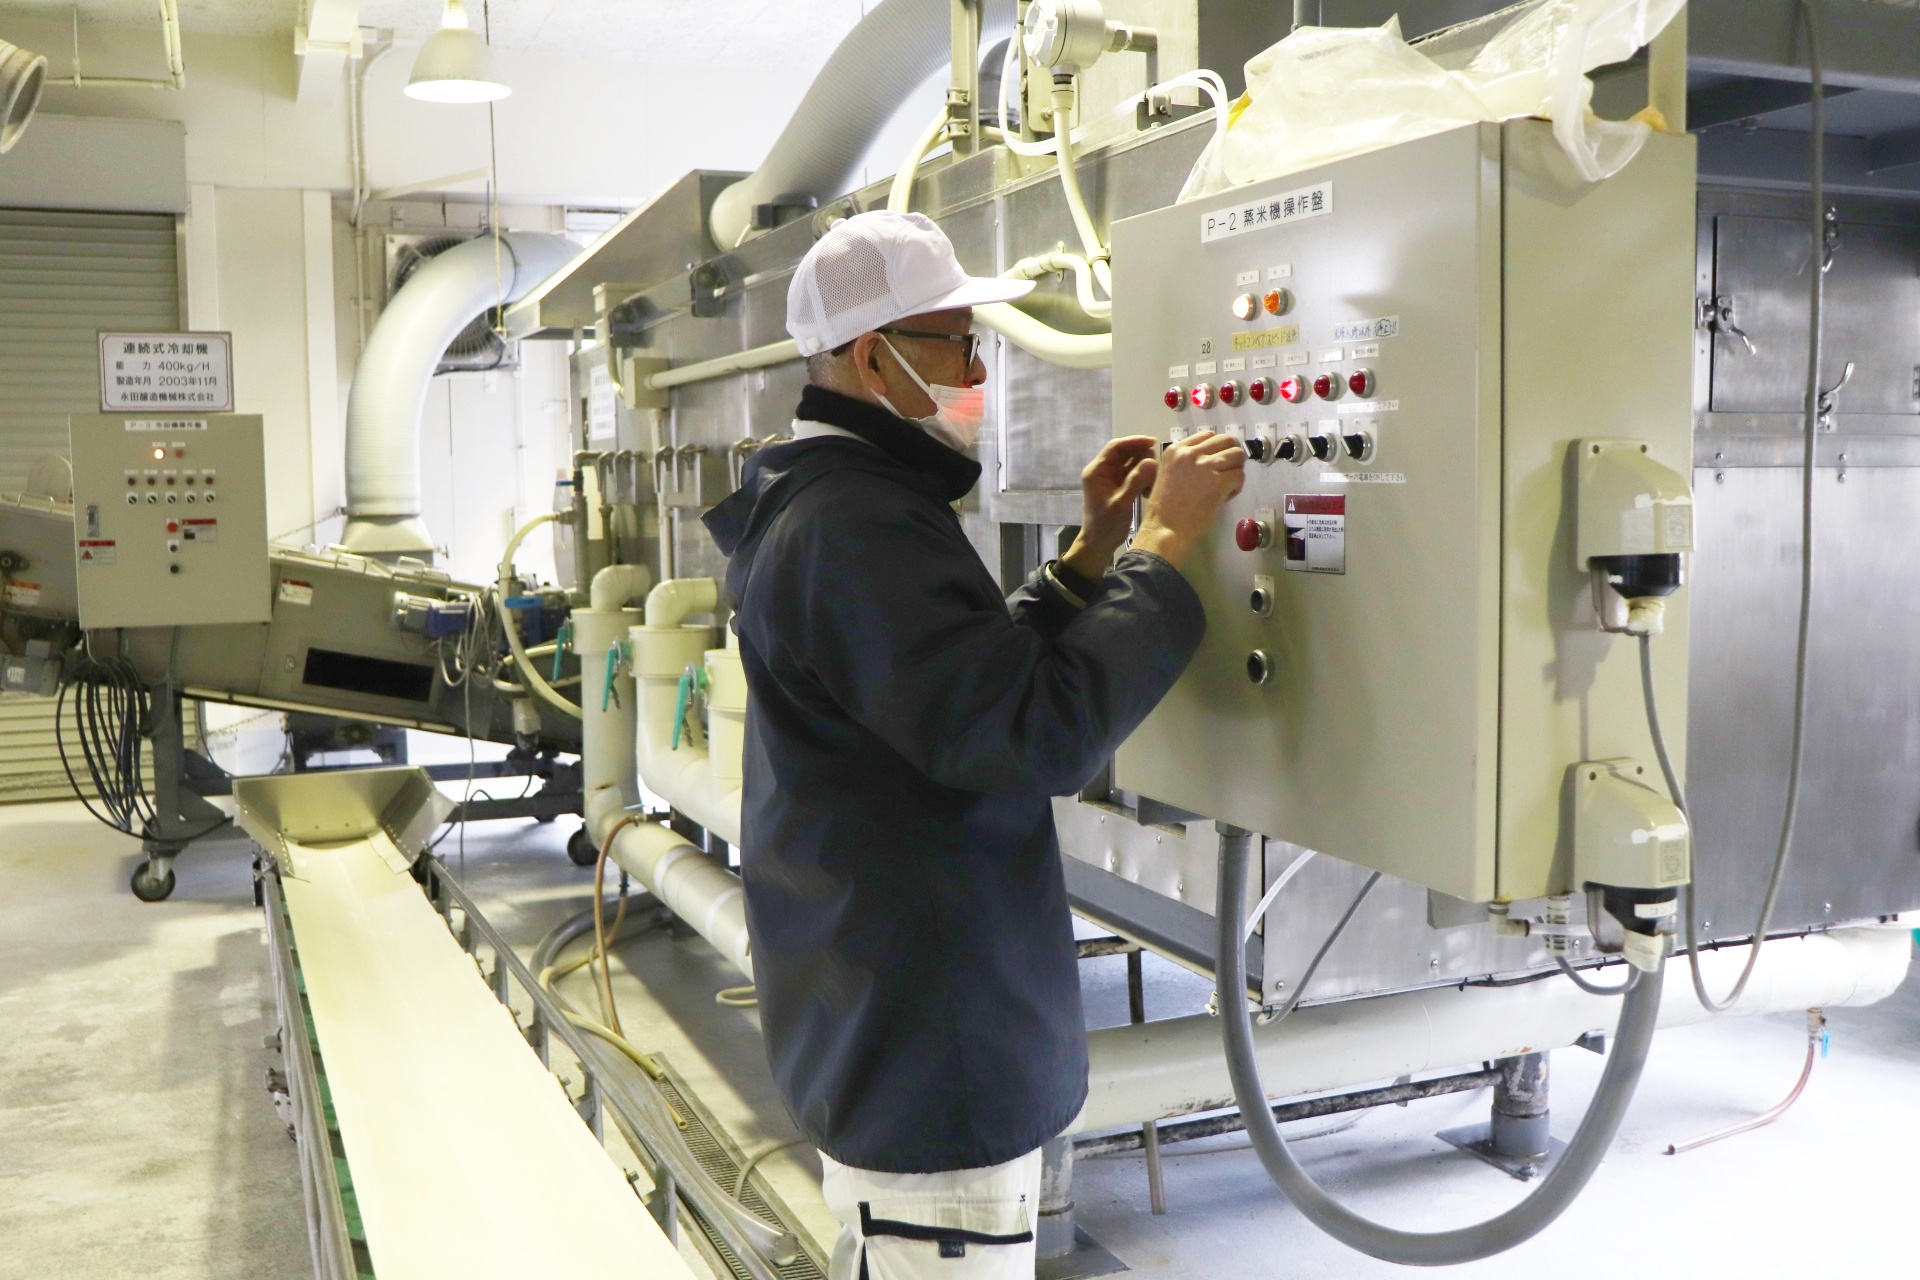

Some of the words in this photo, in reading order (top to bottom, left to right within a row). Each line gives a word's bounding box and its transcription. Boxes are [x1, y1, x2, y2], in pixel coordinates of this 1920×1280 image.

[1207, 212, 1237, 236] P-2
[1243, 190, 1324, 227] 蒸米機操作盤
[123, 342, 208, 354] 連続式冷却機
[1202, 341, 1211, 354] 28
[158, 361, 210, 372] 400kg/H
[116, 376, 151, 386] 製造年月
[159, 376, 217, 386] 2003年11月
